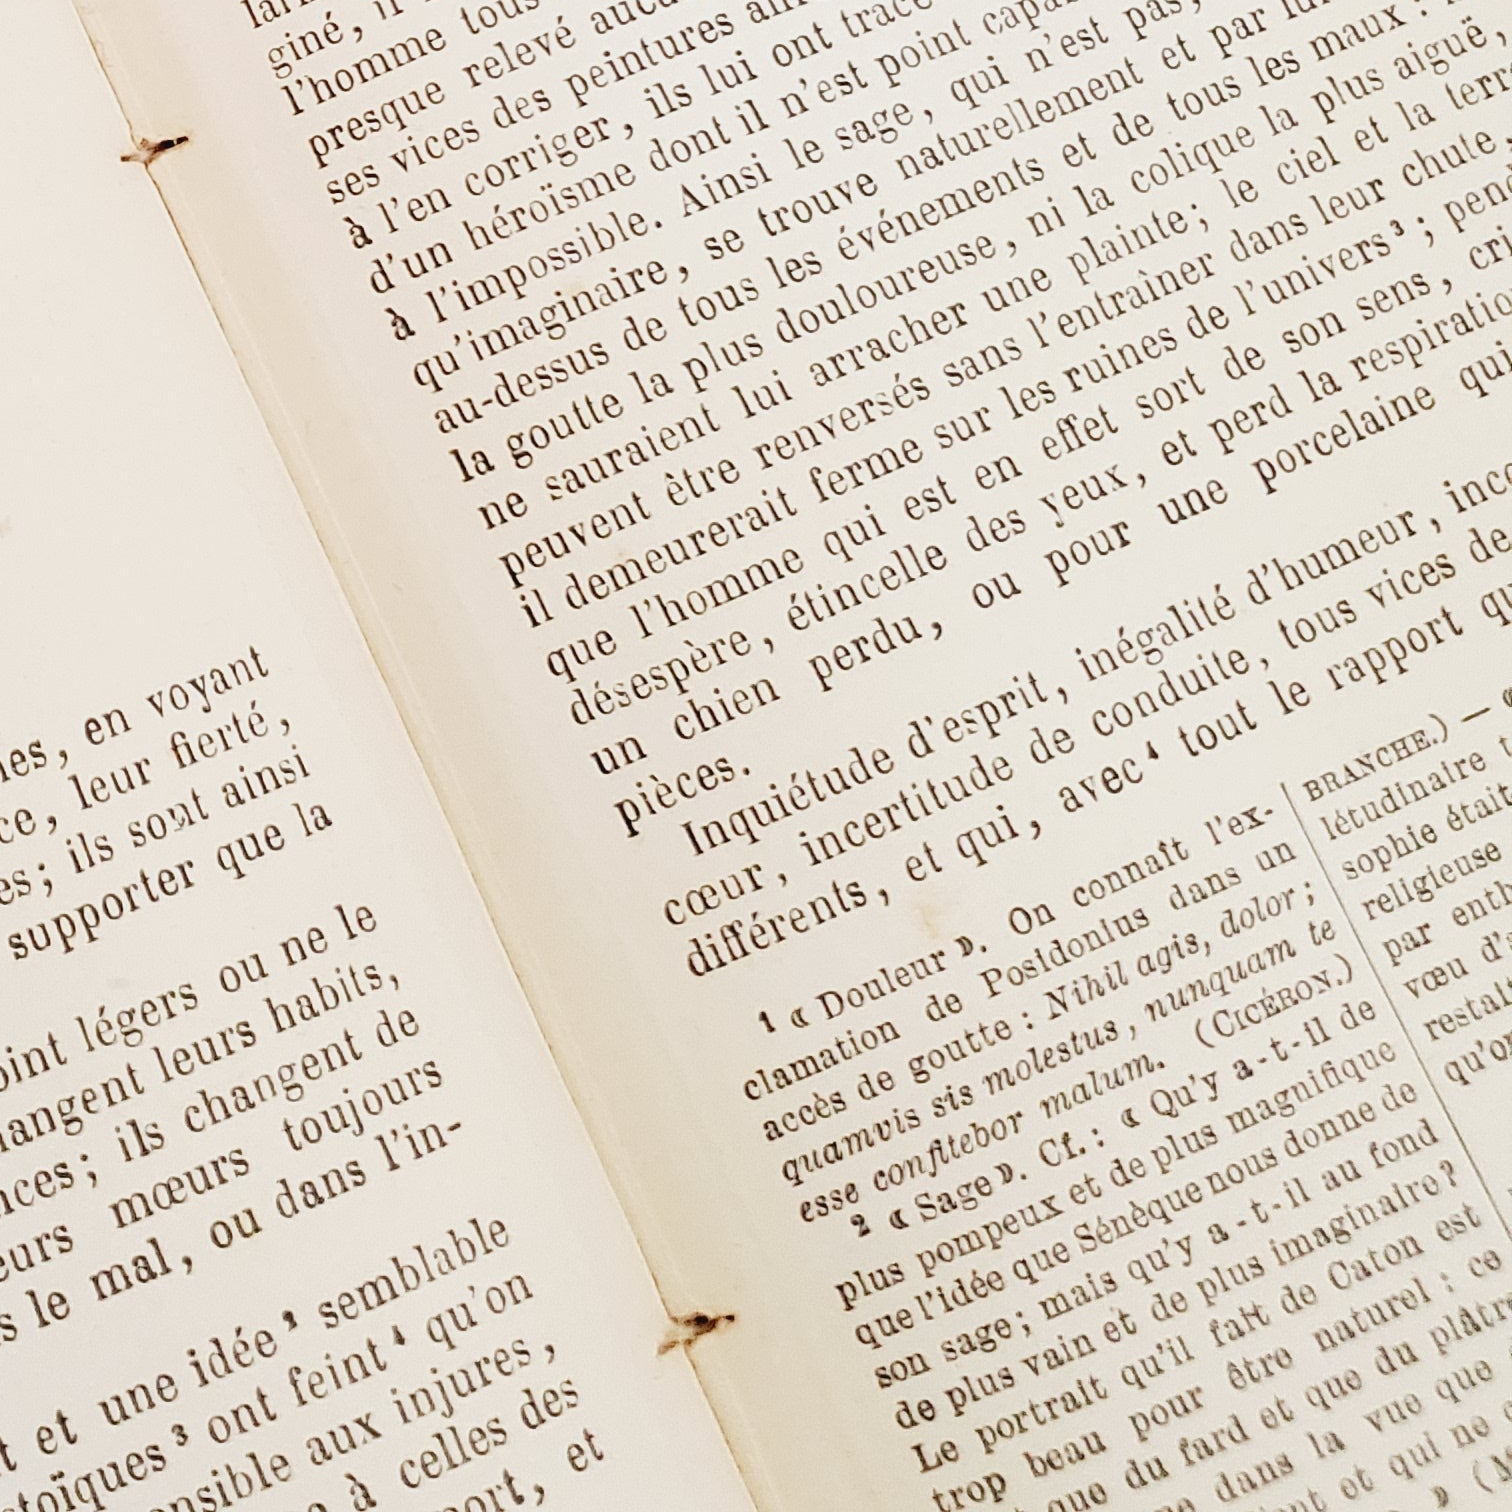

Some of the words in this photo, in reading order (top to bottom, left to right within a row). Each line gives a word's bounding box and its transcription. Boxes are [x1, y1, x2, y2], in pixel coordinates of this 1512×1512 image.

[279, 27, 448, 117] l'homme
[325, 163, 382, 206] ses
[388, 118, 481, 174] vices
[492, 88, 553, 130] des
[562, 11, 736, 109] peintures
[412, 259, 690, 395] qu'imaginaire,
[702, 228, 746, 262] se
[756, 172, 879, 238] trouve
[894, 56, 1146, 182] naturellement
[1160, 32, 1198, 71] et
[1207, 7, 1268, 61] par
[476, 491, 530, 531] ne
[544, 402, 722, 502] sauraient
[729, 368, 794, 420] lui
[808, 301, 970, 388] arracher
[980, 267, 1054, 313] une
[1065, 202, 1210, 287] plainte;
[1217, 177, 1260, 210] le
[1276, 134, 1342, 187] ciel
[1353, 114, 1390, 153] et
[1393, 100, 1438, 132] la
[1443, 63, 1512, 111] terr
[589, 736, 649, 776] un
[672, 677, 782, 741] chien
[807, 615, 944, 694] perdu,
[971, 571, 1023, 610] ou
[1043, 520, 1132, 589] pour
[1156, 478, 1230, 526] une
[1250, 384, 1437, 497] porcelaine
[66, 756, 152, 811] leur
[169, 698, 291, 770] fierté,
[83, 707, 133, 747] en
[144, 644, 270, 719] voyant
[663, 862, 789, 927] cœur,
[797, 753, 1015, 868] incertitude
[1028, 725, 1077, 766] de
[1091, 648, 1270, 738] conduite,
[1276, 598, 1359, 651] tous
[1363, 552, 1458, 610] vices
[1467, 526, 1512, 565] de
[679, 745, 896, 857] Inquiétude
[907, 670, 1069, 760] d'esprit,
[1073, 582, 1237, 682] inégalité
[1246, 509, 1443, 606] d'humeur,
[64, 831, 115, 875] ils
[220, 743, 312, 809] ainsi
[612, 756, 752, 839] pièces.
[1319, 750, 1488, 842] létudinaire
[1341, 822, 1439, 881] sophie
[1445, 782, 1512, 833] était
[1360, 841, 1503, 922] religieuse
[742, 1020, 902, 1102] clamation
[924, 992, 964, 1023] de
[976, 906, 1151, 1000] Posidonius
[1168, 866, 1243, 912] dans
[1254, 841, 1298, 873] un
[780, 1107, 922, 1189] quamvis
[930, 1083, 975, 1119] sis
[981, 1018, 1137, 1096] molestus,
[1143, 938, 1298, 1023] nunquam
[1307, 918, 1337, 947] te
[107, 1147, 251, 1230] mœurs
[282, 1059, 443, 1153] toujours
[798, 1181, 860, 1224] esse
[872, 1109, 1024, 1193] confitebor
[1038, 1052, 1166, 1120] malum.
[833, 1261, 906, 1313] plus
[914, 1193, 1066, 1280] pompeux
[1068, 1172, 1104, 1206] et
[1108, 1156, 1148, 1189] de
[1149, 1123, 1220, 1176] plus
[1223, 1041, 1397, 1135] magnifique
[894, 1398, 938, 1431] de
[942, 1365, 1016, 1419] plus
[1019, 1333, 1098, 1378] vain
[1102, 1308, 1139, 1345] et
[1150, 1290, 1190, 1323] de
[1195, 1254, 1266, 1309] plus
[398, 1416, 508, 1490] celles
[519, 1378, 580, 1431] des
